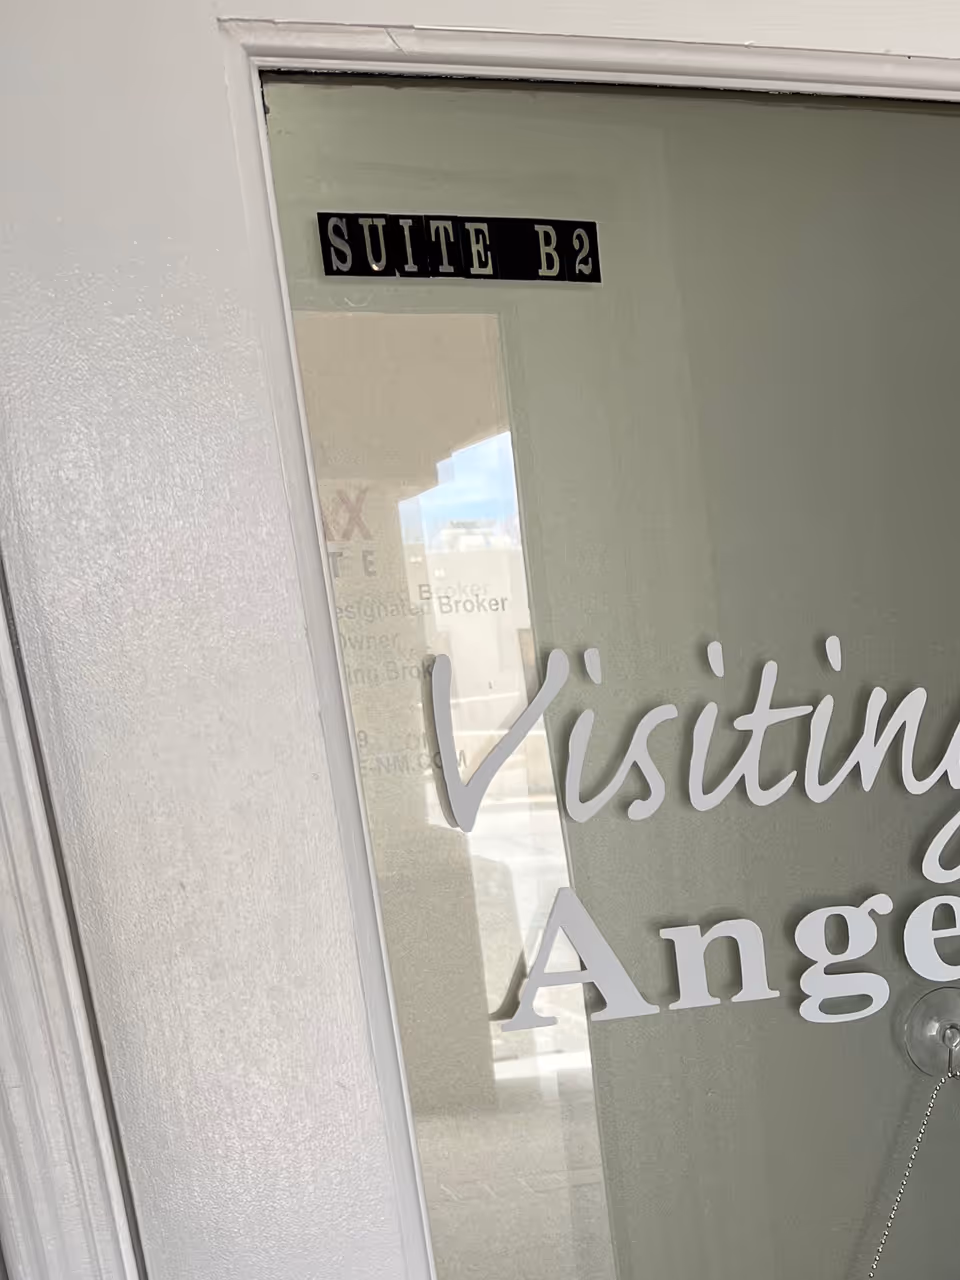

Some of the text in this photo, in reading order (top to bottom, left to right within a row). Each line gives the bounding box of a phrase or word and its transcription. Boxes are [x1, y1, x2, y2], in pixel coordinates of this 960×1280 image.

[327, 216, 594, 277] SUITE B2
[336, 593, 508, 624] esignated Broker
